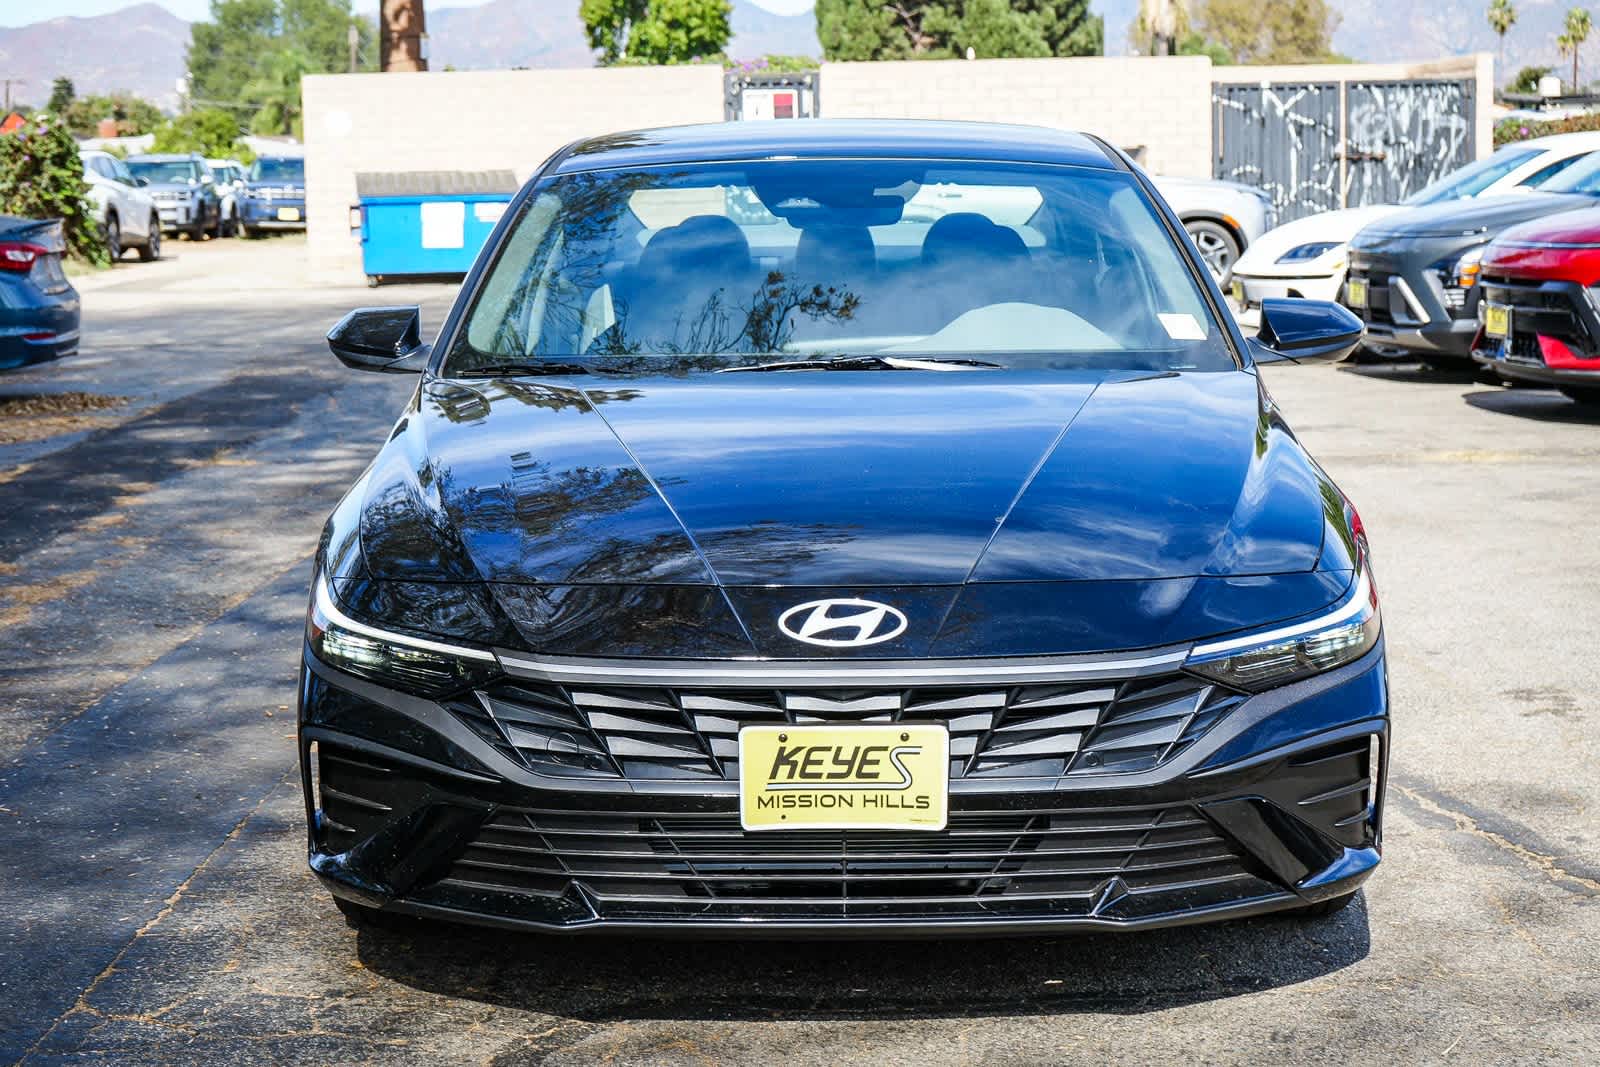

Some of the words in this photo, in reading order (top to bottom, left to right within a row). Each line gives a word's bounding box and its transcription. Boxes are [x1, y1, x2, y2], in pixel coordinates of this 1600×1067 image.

[765, 745, 922, 791] KEYES
[757, 794, 854, 810] MISSION
[863, 794, 930, 809] HILLS
